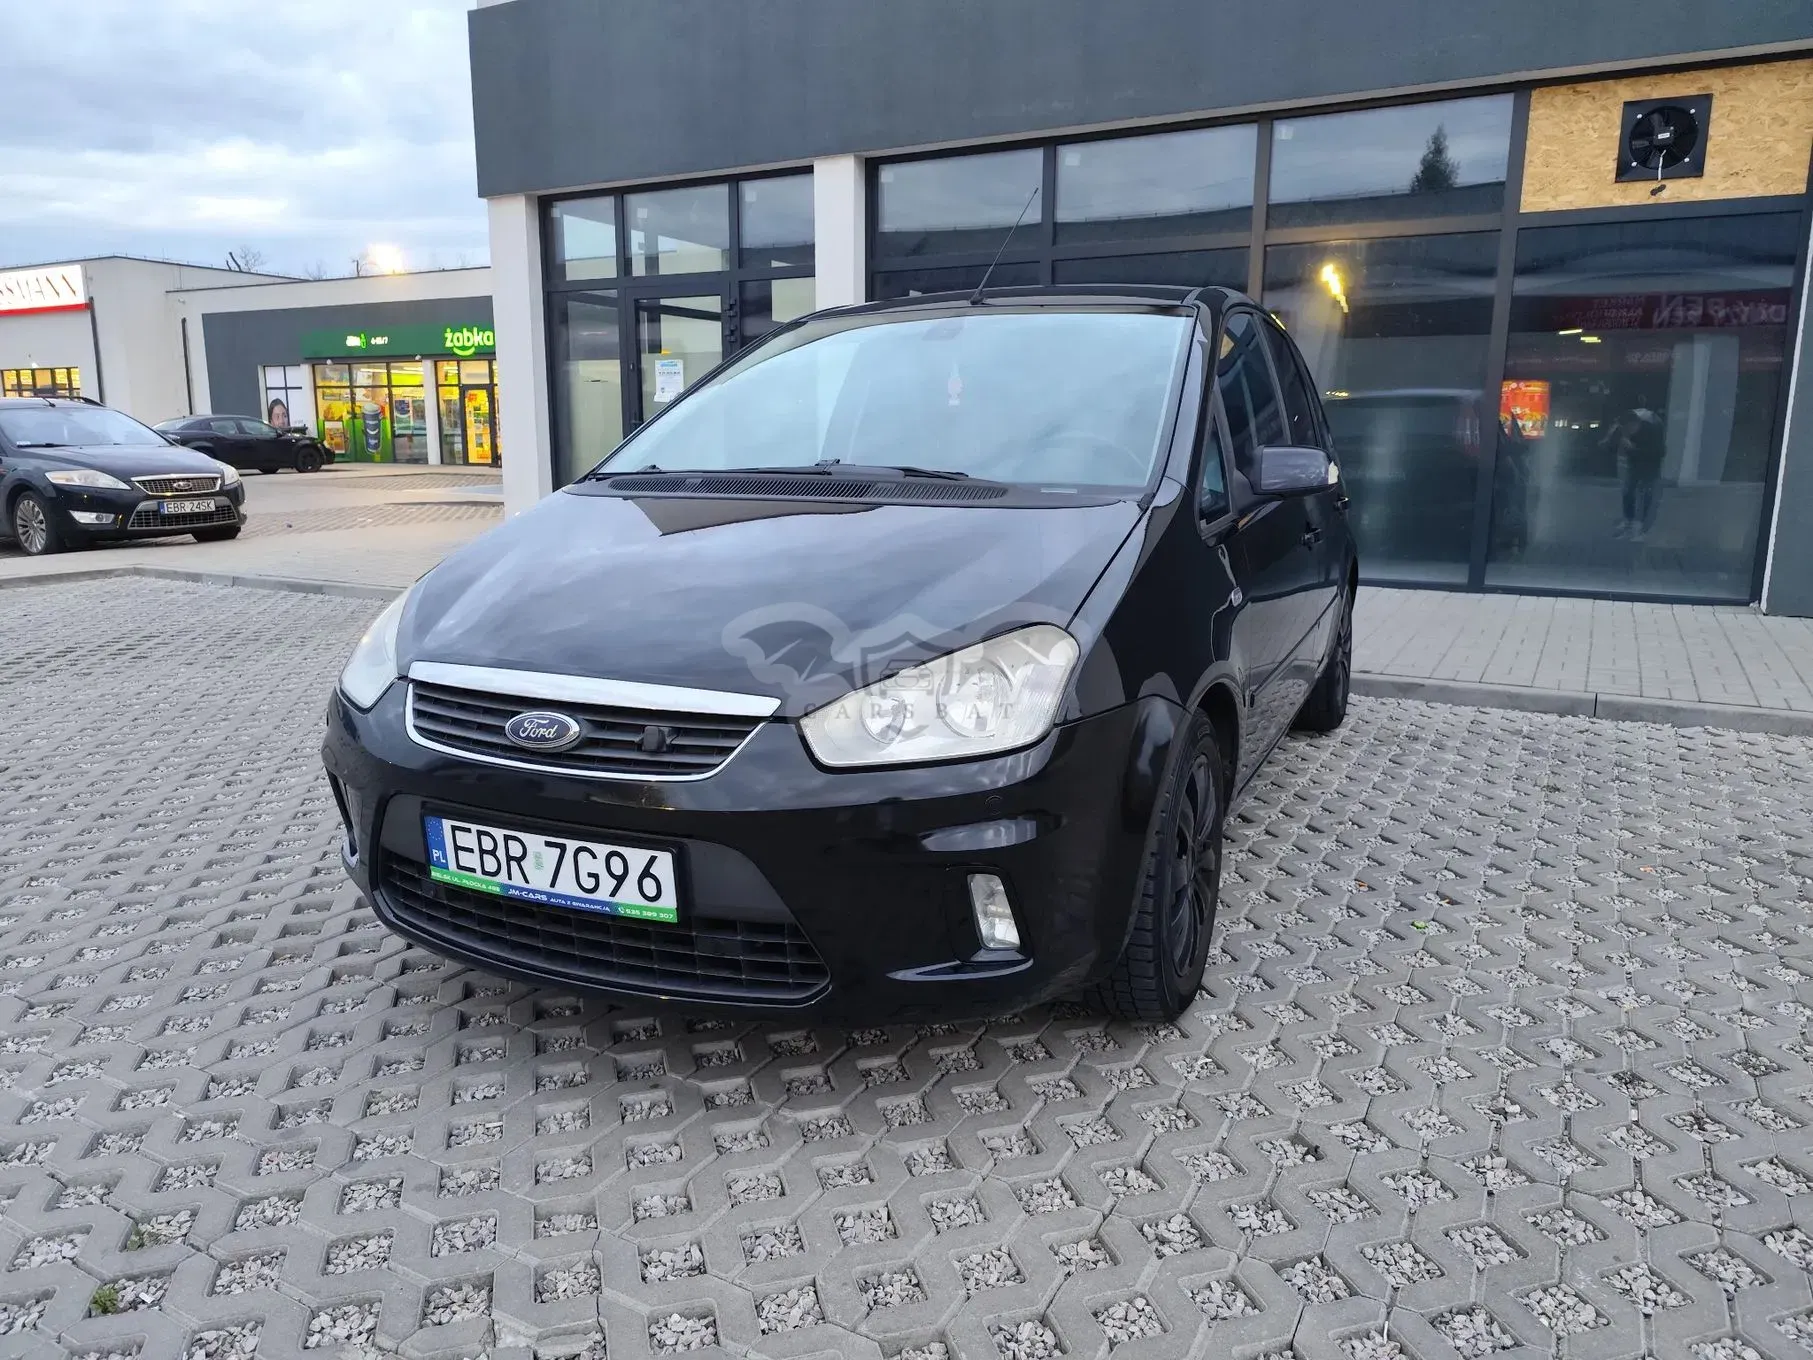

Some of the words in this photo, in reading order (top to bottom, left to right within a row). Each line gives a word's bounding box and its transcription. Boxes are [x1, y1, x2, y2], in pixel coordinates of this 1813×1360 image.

[444, 327, 494, 347] żabka
[166, 502, 187, 513] EBR
[190, 501, 212, 511] 24SK
[519, 718, 558, 738] Ford
[433, 849, 446, 863] PL
[450, 825, 529, 884] EBR
[544, 840, 662, 902] 7G96
[508, 888, 548, 902] JM-CARS
